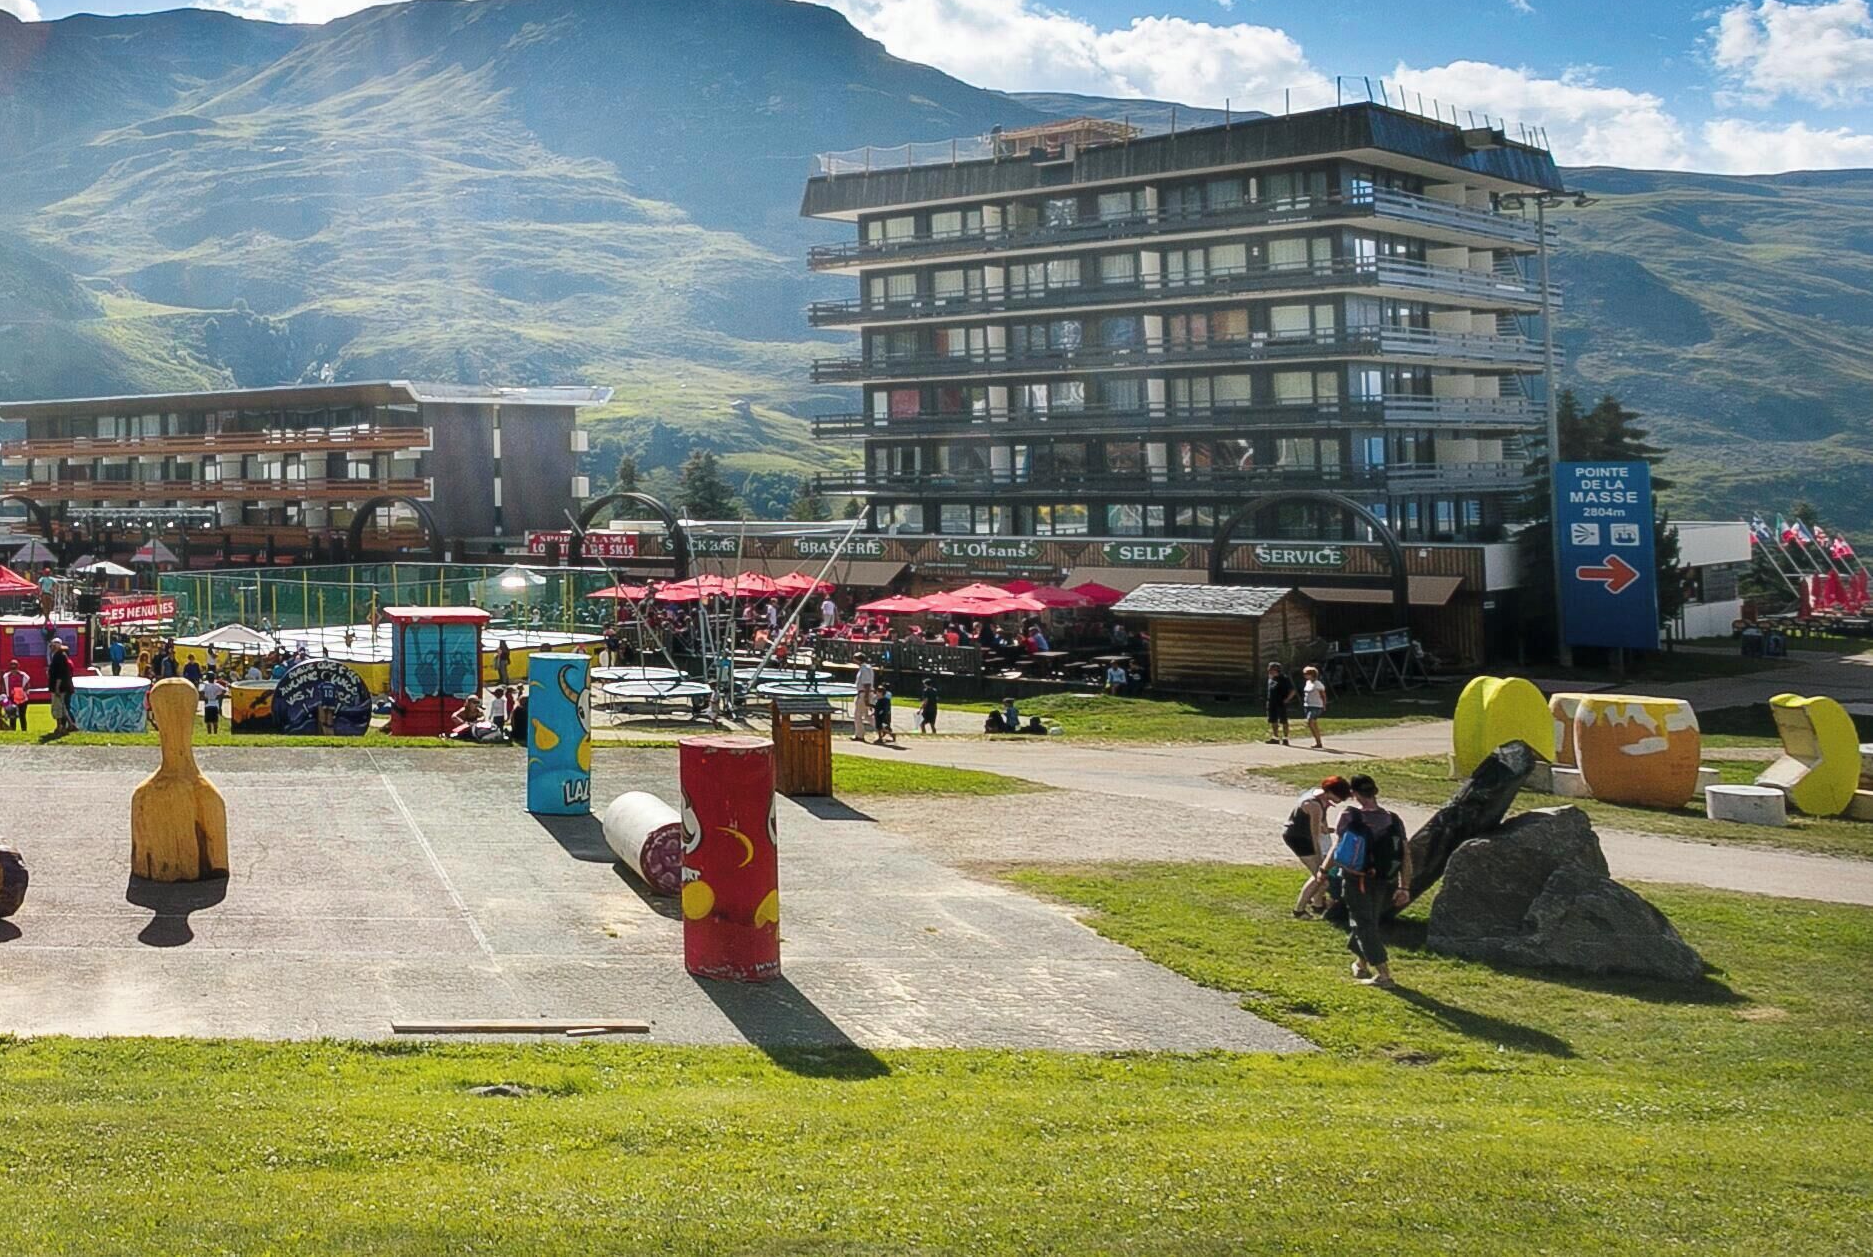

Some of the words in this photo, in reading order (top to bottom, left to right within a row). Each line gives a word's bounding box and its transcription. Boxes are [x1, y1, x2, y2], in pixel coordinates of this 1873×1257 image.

[1575, 467, 1629, 477] POINTE
[1581, 479, 1601, 490] DE
[1605, 479, 1625, 490] LA
[1569, 491, 1638, 503] MASSE
[1582, 507, 1626, 517] 2804m
[532, 542, 587, 555] LOTIN
[609, 544, 635, 555] SKIS
[665, 538, 707, 552] SCK
[709, 540, 736, 552] BAR
[800, 540, 881, 554] BRASSERIE
[1259, 548, 1342, 564] SERVICE
